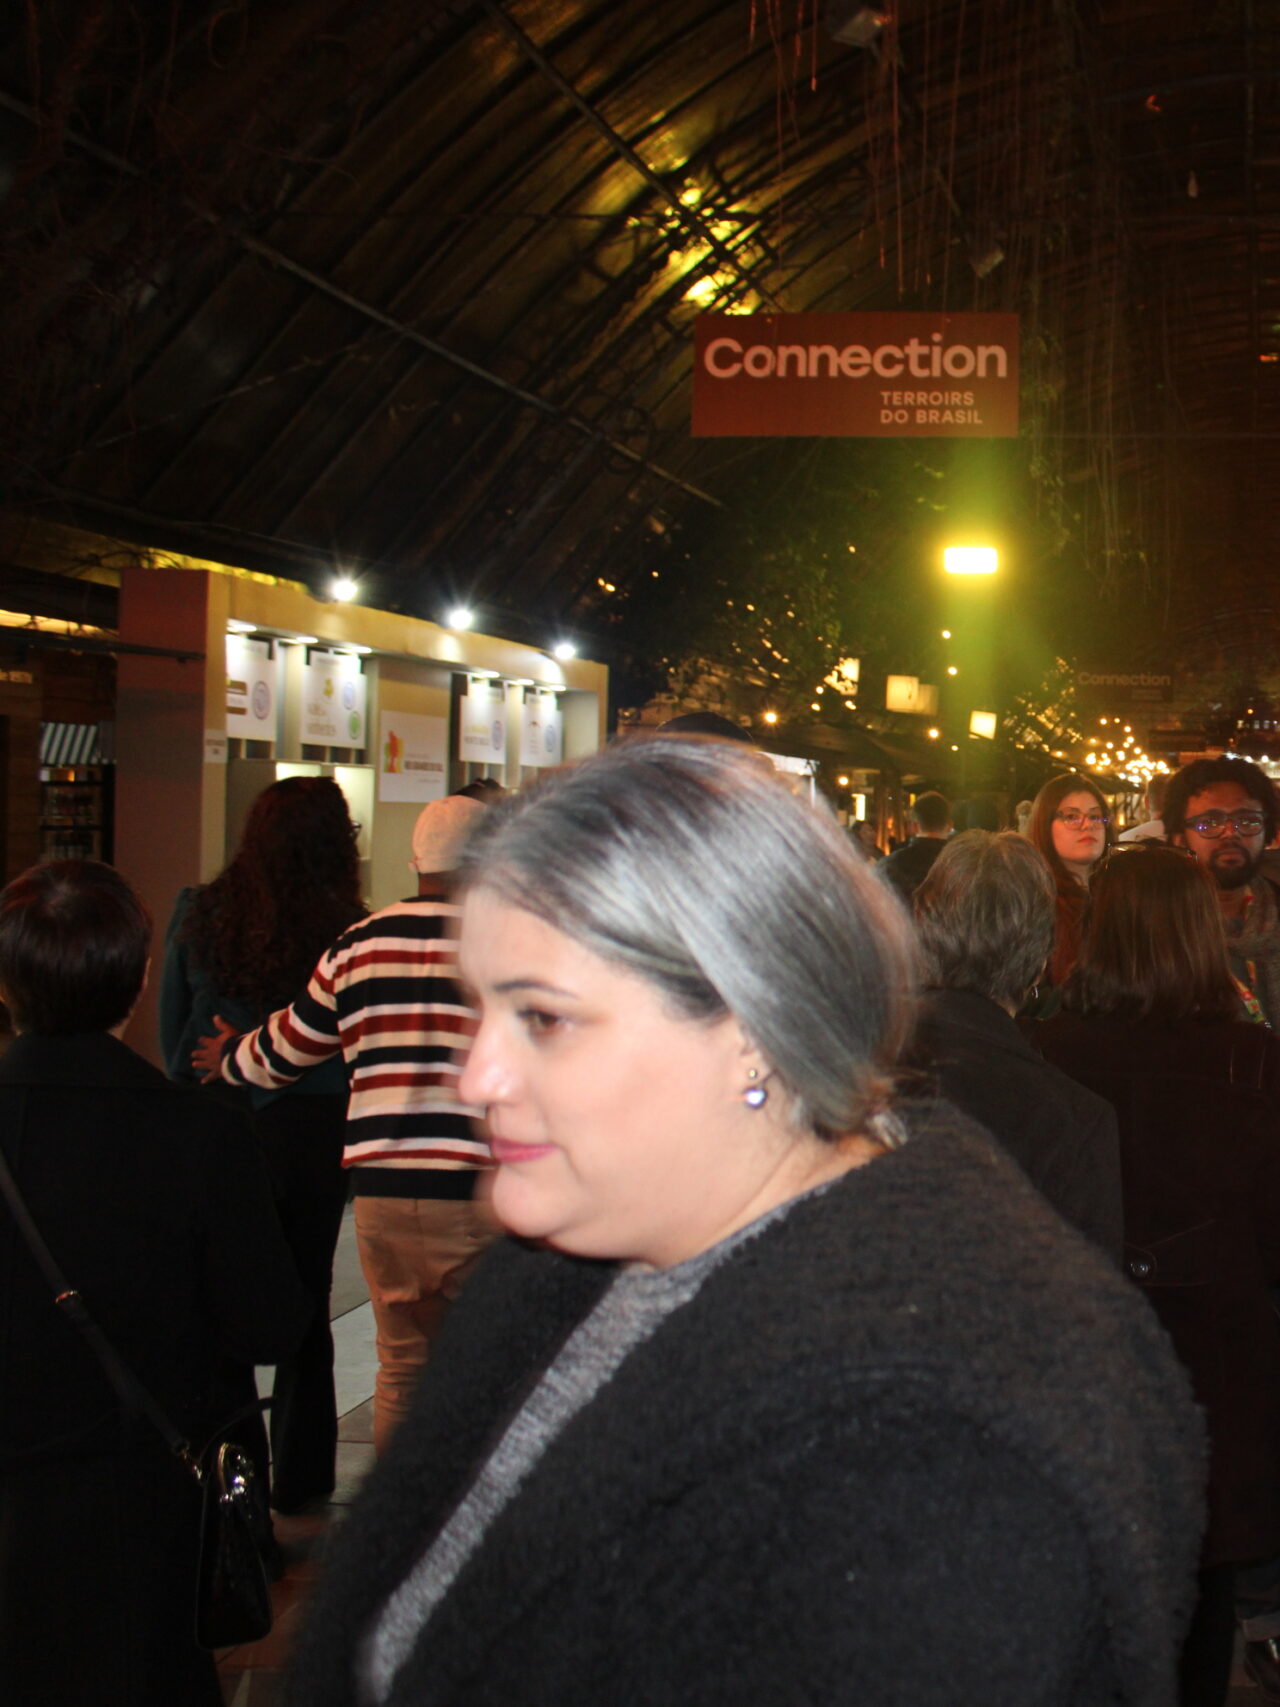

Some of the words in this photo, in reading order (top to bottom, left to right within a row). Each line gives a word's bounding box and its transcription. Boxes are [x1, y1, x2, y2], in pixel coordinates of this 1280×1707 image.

[703, 332, 1008, 379] Connection
[880, 390, 975, 406] TERROIRS
[880, 408, 909, 424] DO
[915, 408, 983, 425] BRASIL
[1077, 671, 1171, 686] Connection
